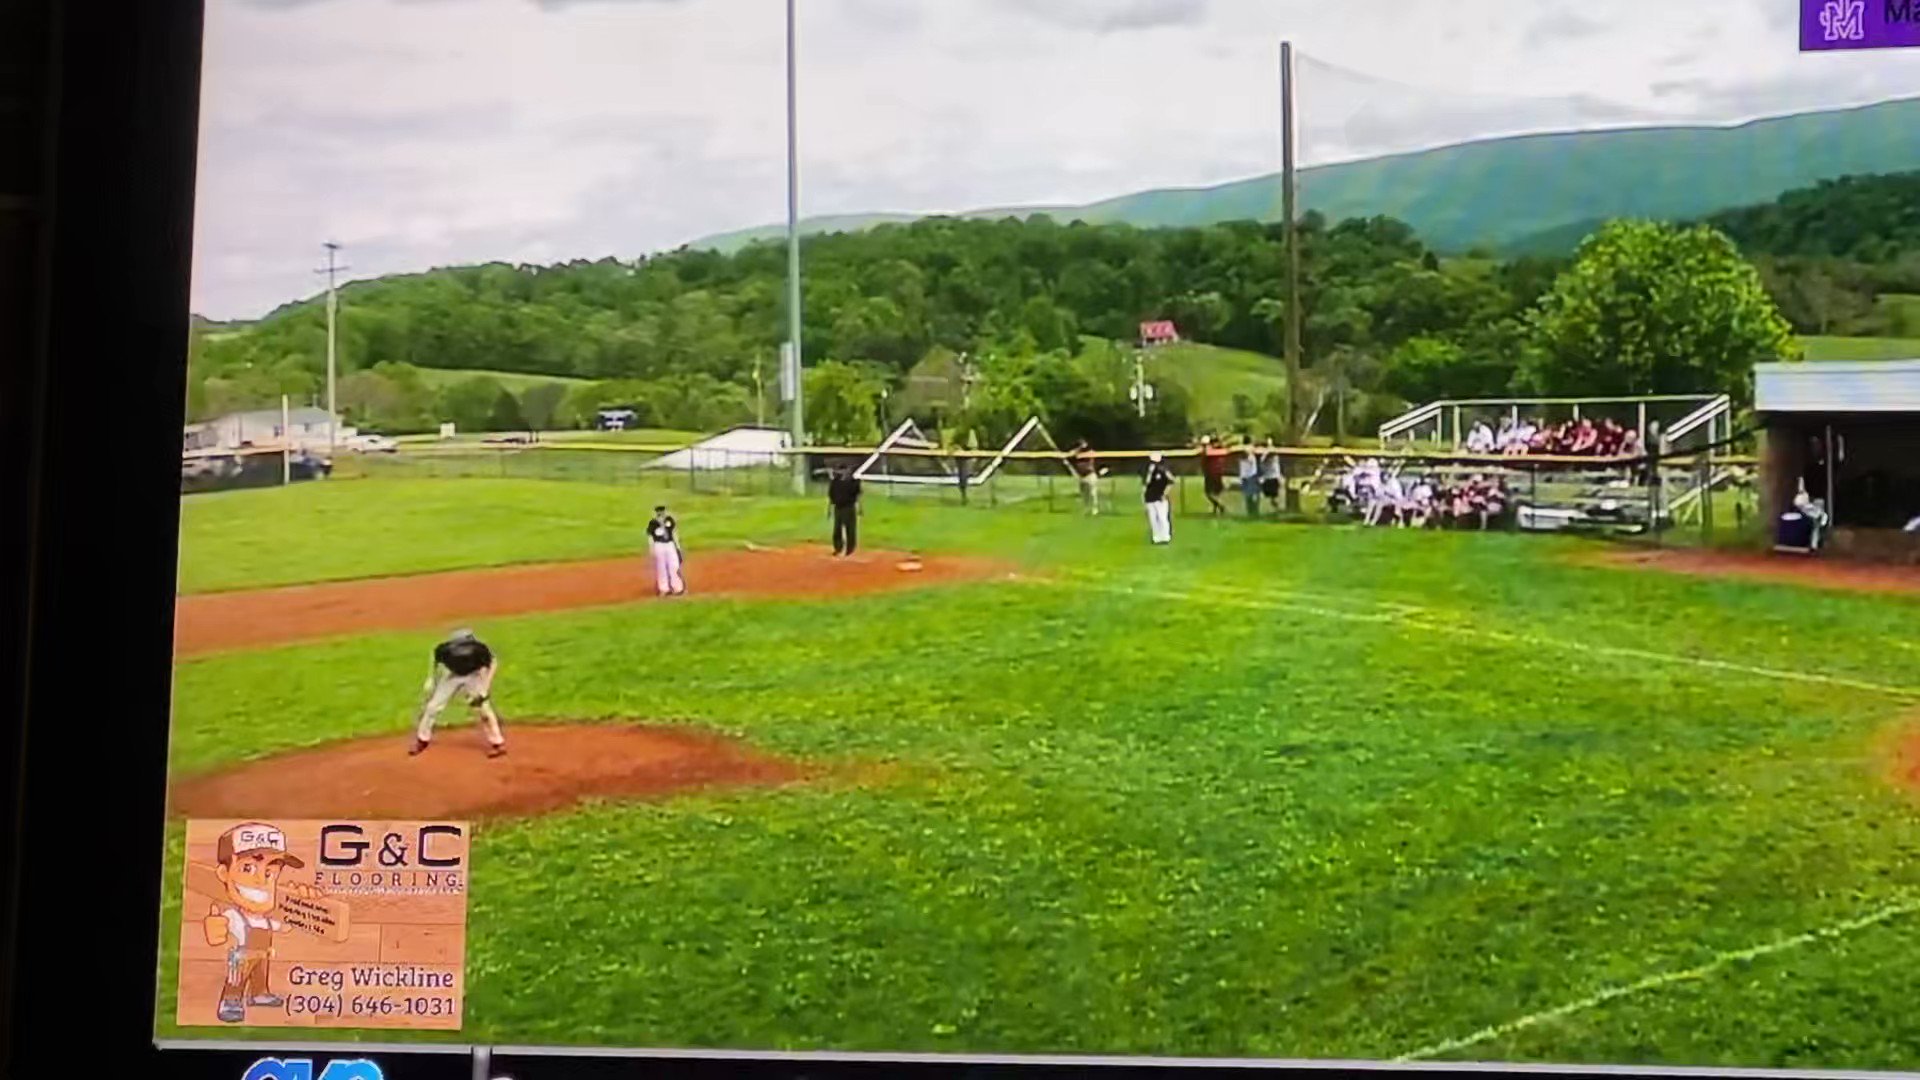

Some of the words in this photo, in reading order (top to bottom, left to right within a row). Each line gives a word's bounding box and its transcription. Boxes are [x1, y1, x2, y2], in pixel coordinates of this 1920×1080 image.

[289, 966, 344, 991] Greg
[352, 967, 453, 988] Wickline
[285, 994, 343, 1017] (304)
[352, 995, 454, 1016] 646-1031
